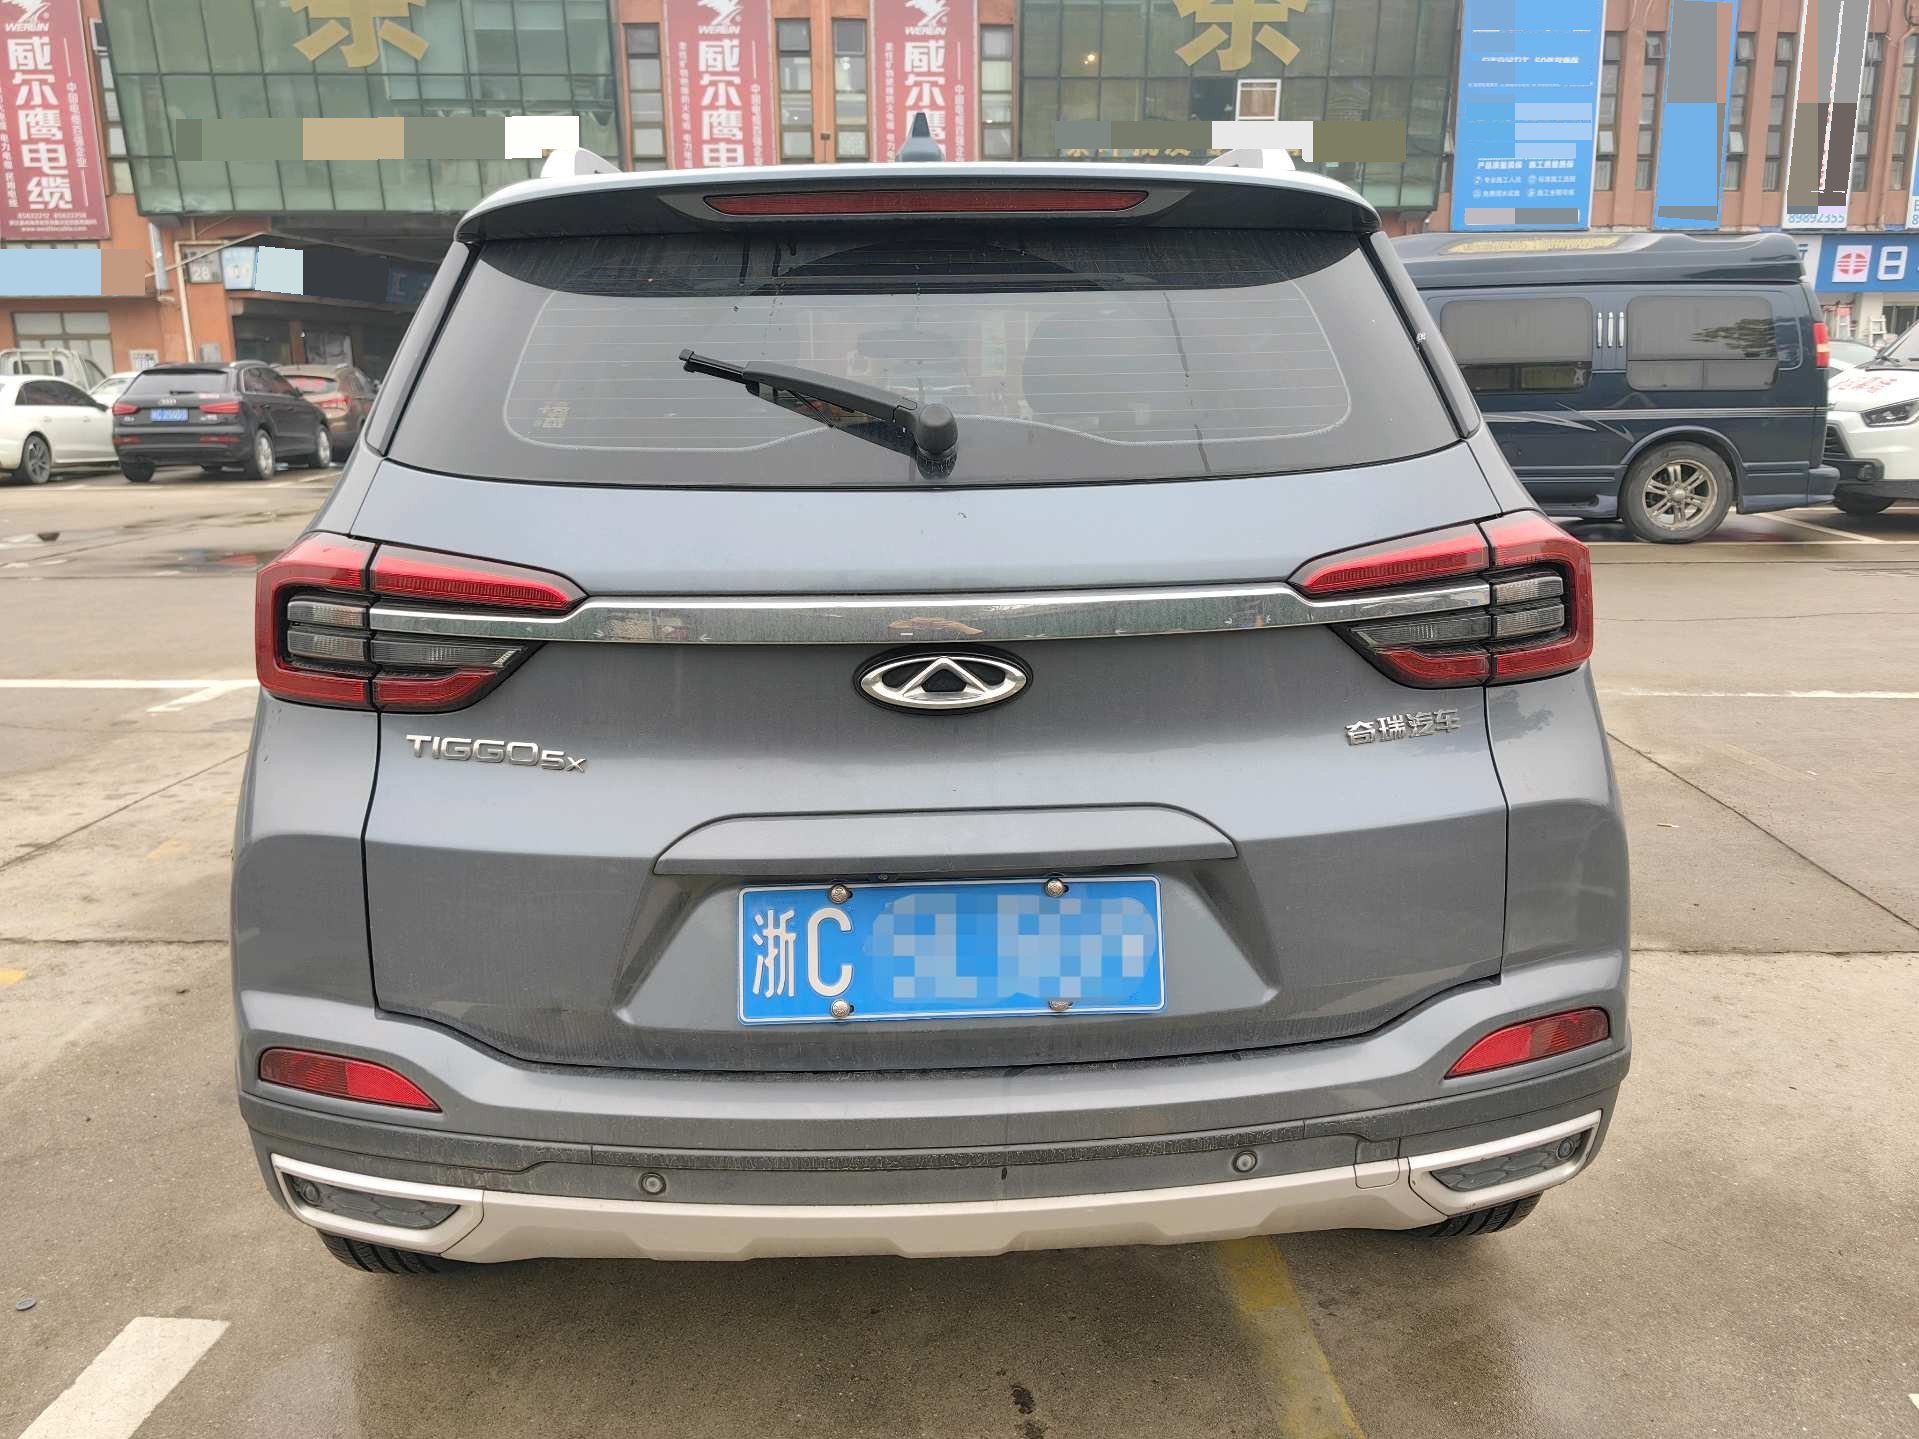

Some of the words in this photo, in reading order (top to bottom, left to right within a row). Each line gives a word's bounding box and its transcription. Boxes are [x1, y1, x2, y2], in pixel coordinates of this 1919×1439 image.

[7, 36, 73, 210] 威尔鹰电缆
[1344, 708, 1461, 746] 奇瑞汽车
